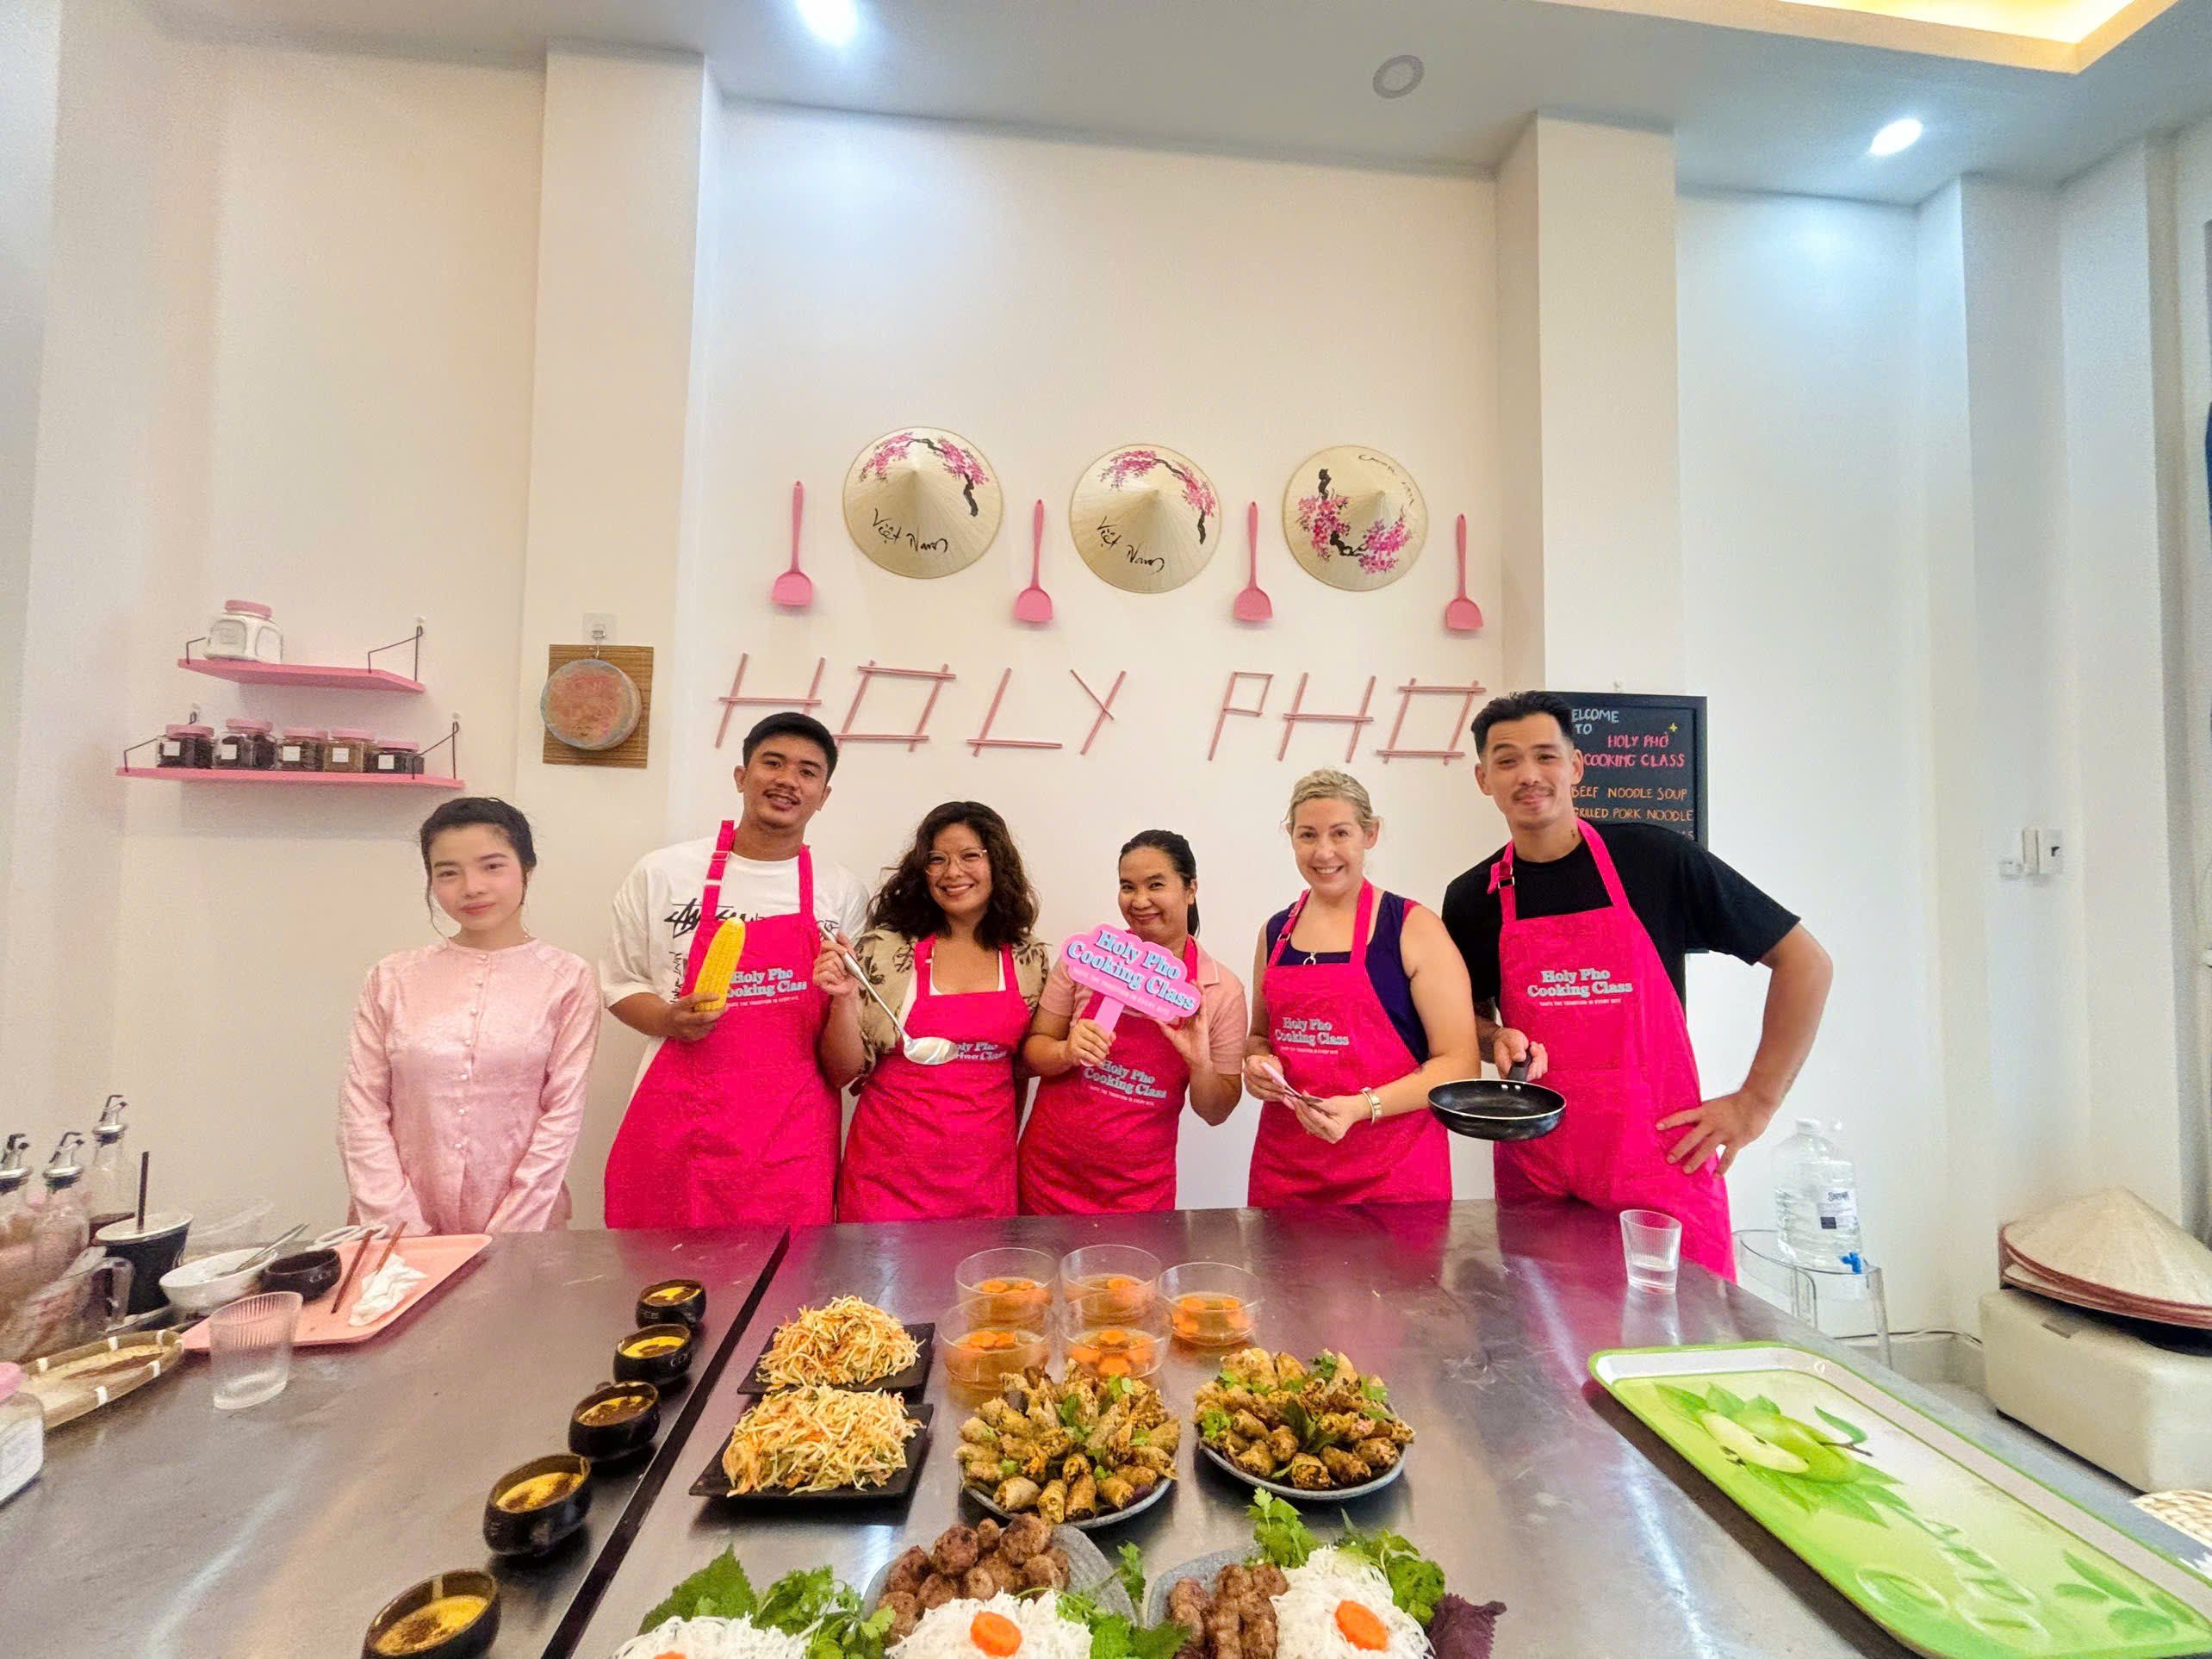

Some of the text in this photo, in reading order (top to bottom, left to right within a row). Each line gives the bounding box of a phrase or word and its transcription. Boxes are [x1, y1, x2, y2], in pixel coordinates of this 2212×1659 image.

[718, 652, 1487, 766] HOLY PHO
[1571, 708, 1619, 724] ELCOME
[1575, 723, 1593, 736] TO
[1606, 734, 1639, 749] HOLY
[1583, 753, 1686, 767] COOKING CLASS
[1571, 785, 1688, 801] BEEF NOODLE SOUP
[1612, 807, 1642, 819] PORK
[1646, 809, 1694, 822] NOODLE
[1094, 929, 1182, 981] Holy Pho
[767, 967, 794, 981] Pho
[1066, 941, 1145, 991] Cooking
[1145, 975, 1196, 1011] Class
[1540, 967, 1611, 985] Holy Pho
[727, 979, 808, 998] ooking Class
[1526, 980, 1634, 998] Cooking Class
[1317, 1032, 1350, 1046] Class
[1083, 1066, 1135, 1095] Cooking
[1130, 1069, 1156, 1084] Pho
